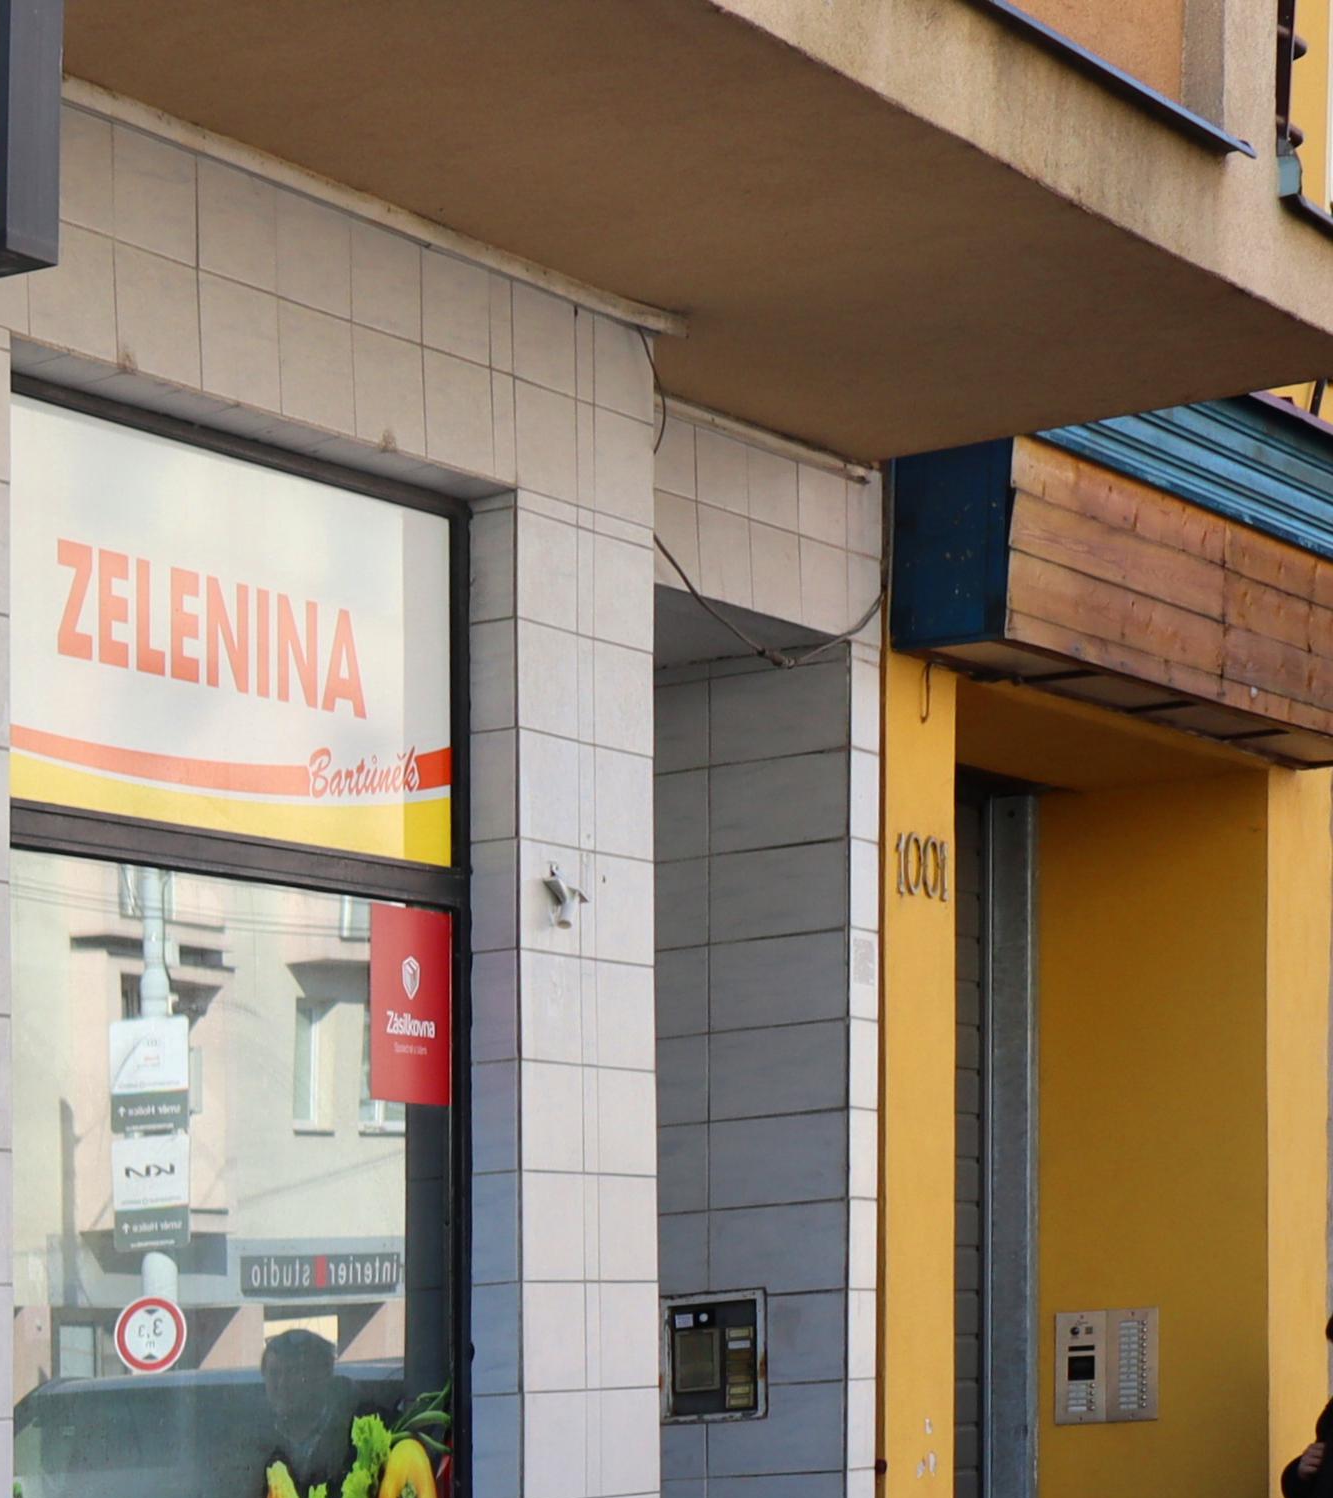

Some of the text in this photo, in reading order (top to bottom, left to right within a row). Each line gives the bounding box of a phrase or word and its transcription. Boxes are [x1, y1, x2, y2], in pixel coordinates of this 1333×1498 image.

[56, 537, 367, 720] ZELENINA
[895, 832, 950, 902] 1001
[385, 1010, 436, 1039] Zásilkovna
